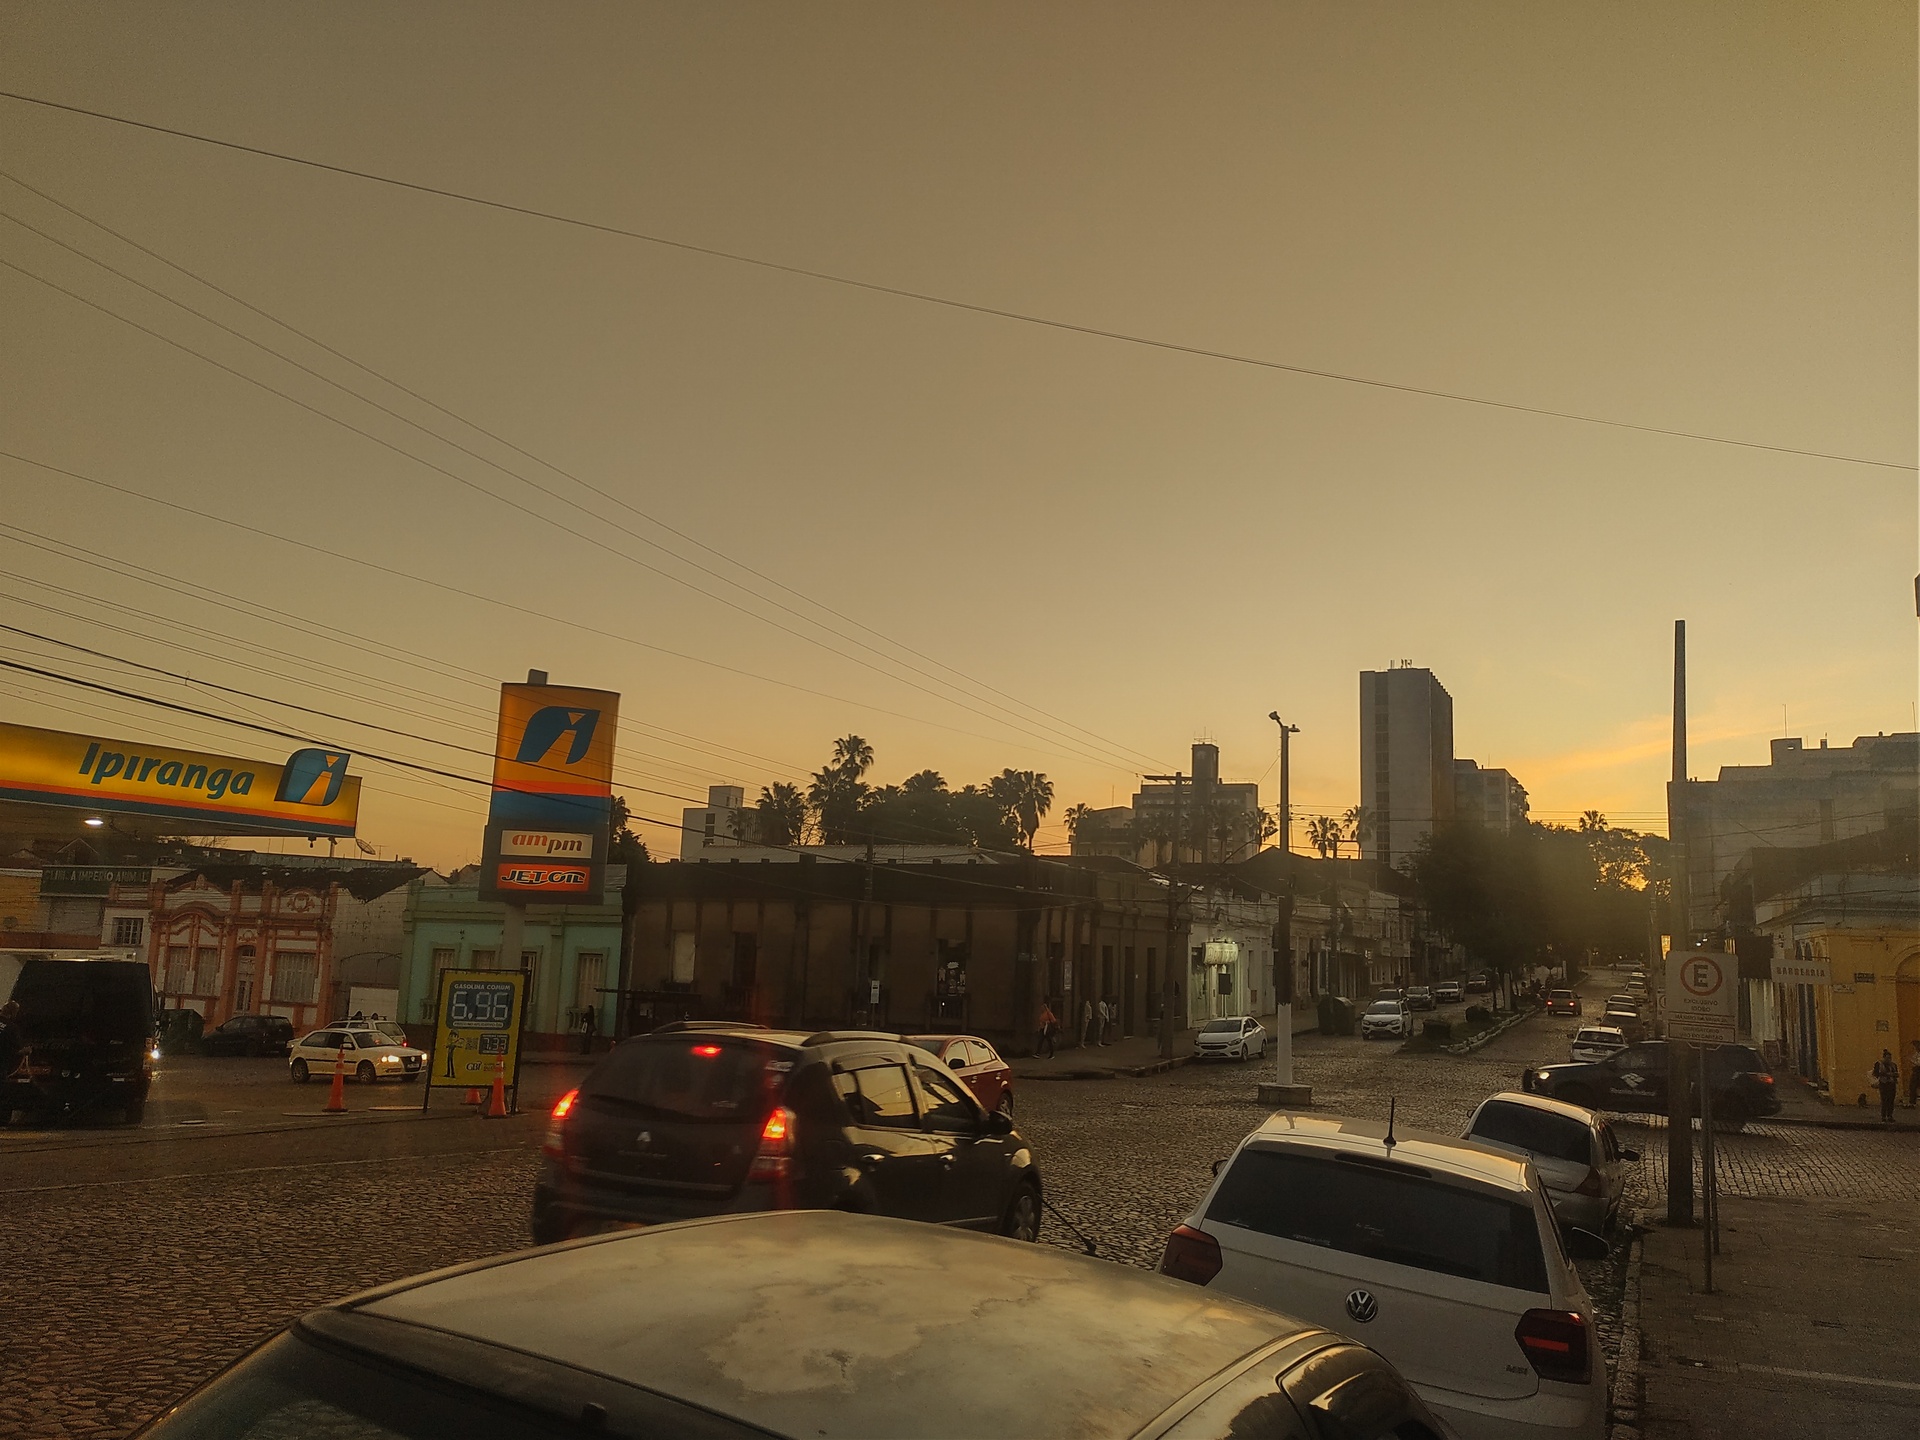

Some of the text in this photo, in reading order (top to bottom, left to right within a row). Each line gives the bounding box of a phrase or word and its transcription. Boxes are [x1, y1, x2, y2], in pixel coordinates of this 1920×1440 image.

[78, 742, 256, 800] Ipiranga
[512, 834, 583, 854] ampm
[1693, 964, 1709, 988] E
